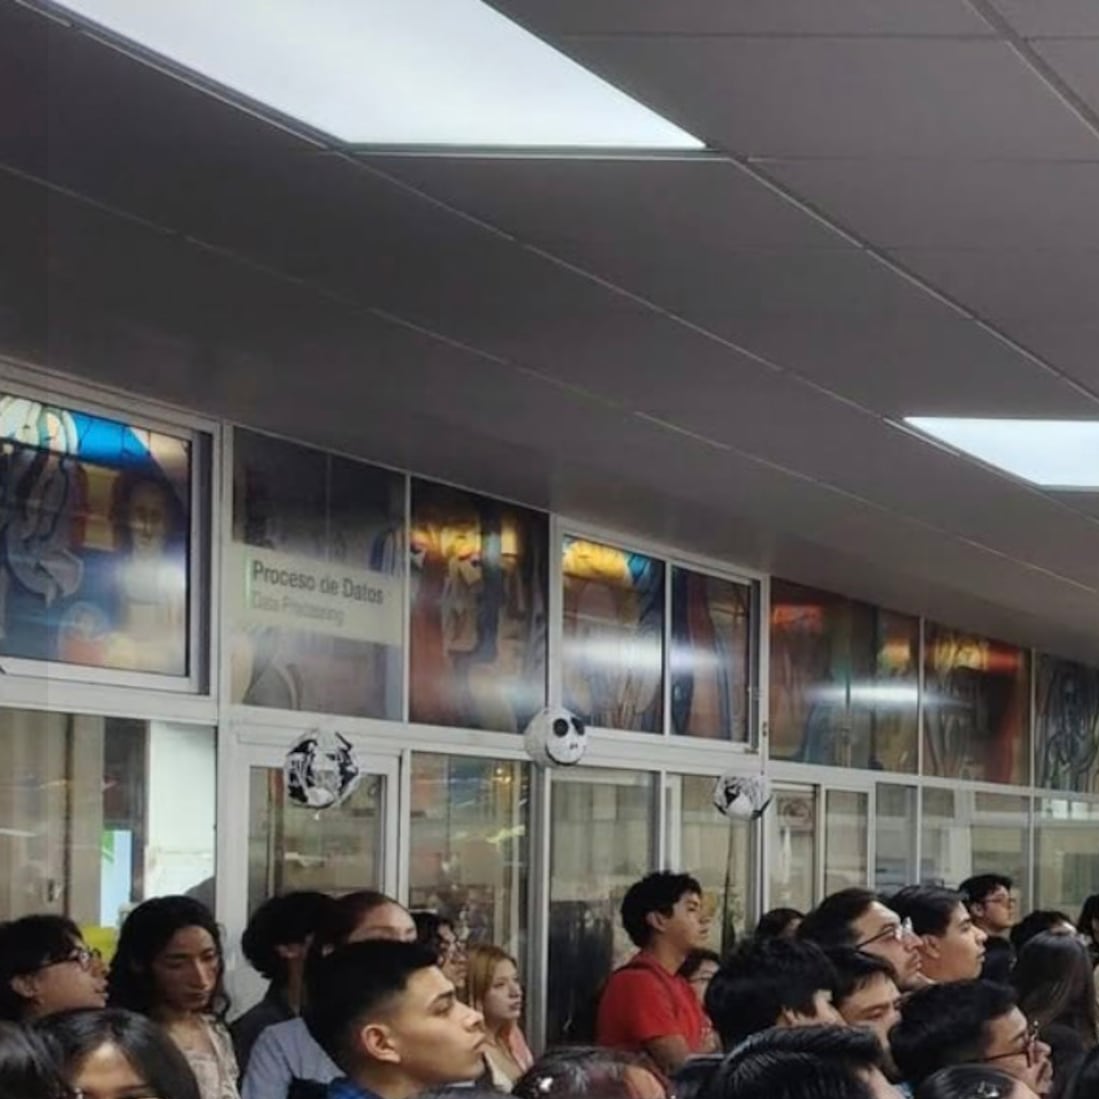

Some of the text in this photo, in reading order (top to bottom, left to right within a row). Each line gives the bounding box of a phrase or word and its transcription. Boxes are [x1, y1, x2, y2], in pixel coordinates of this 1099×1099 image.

[252, 559, 383, 606] Proceso de Datos
